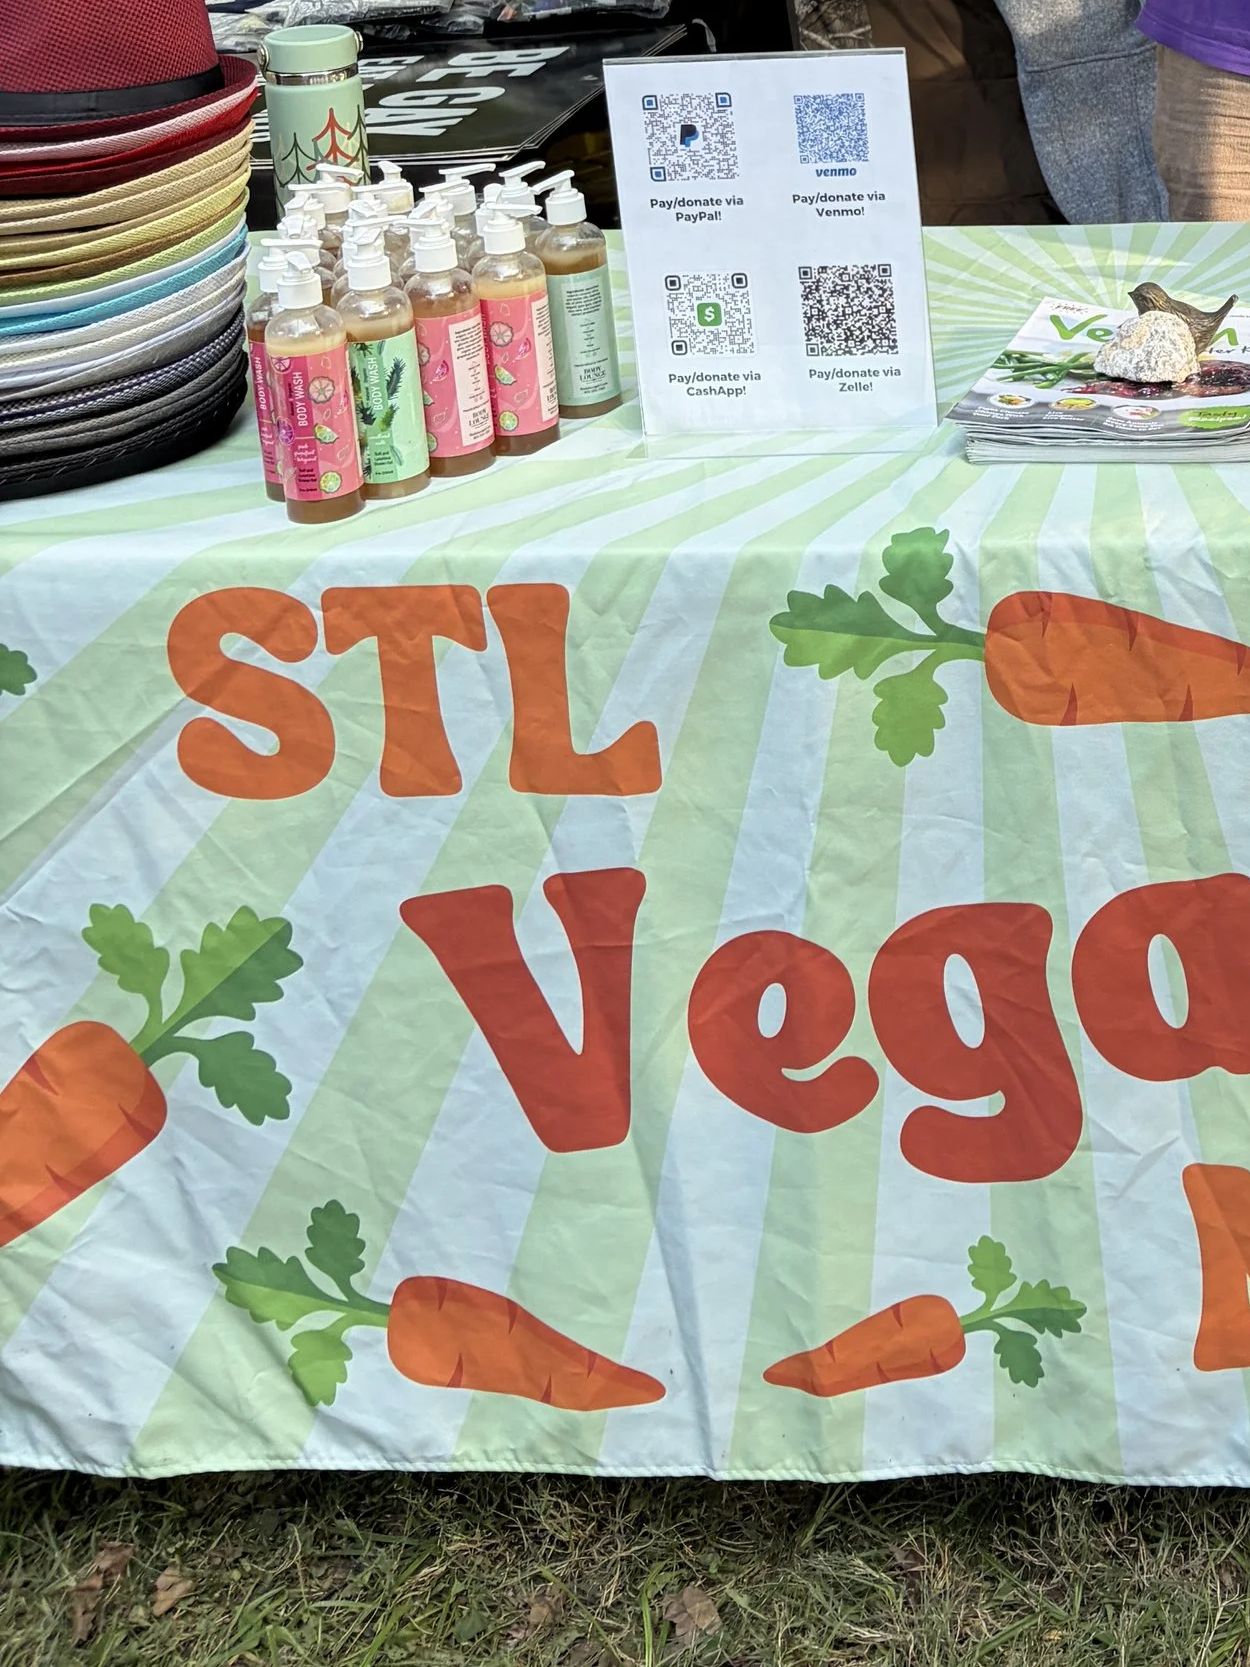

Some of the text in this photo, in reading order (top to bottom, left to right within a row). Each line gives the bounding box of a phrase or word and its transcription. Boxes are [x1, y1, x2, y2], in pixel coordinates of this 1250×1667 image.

[815, 166, 857, 178] venmo
[649, 195, 744, 211] Pay/donate via
[792, 190, 886, 206] Pay/donate via
[675, 209, 722, 223] PayPal!
[815, 205, 866, 217] Venmo!
[1050, 314, 1239, 346] Ven
[668, 370, 761, 385] Pay/donate via
[808, 366, 901, 381] Pay/donate via
[254, 357, 267, 409] BODY WASH
[367, 357, 384, 411] BODY WASH
[838, 381, 873, 393] Zelle!
[686, 385, 747, 397] CashApp!
[292, 372, 309, 427] BODY WASH
[167, 583, 662, 800] STL
